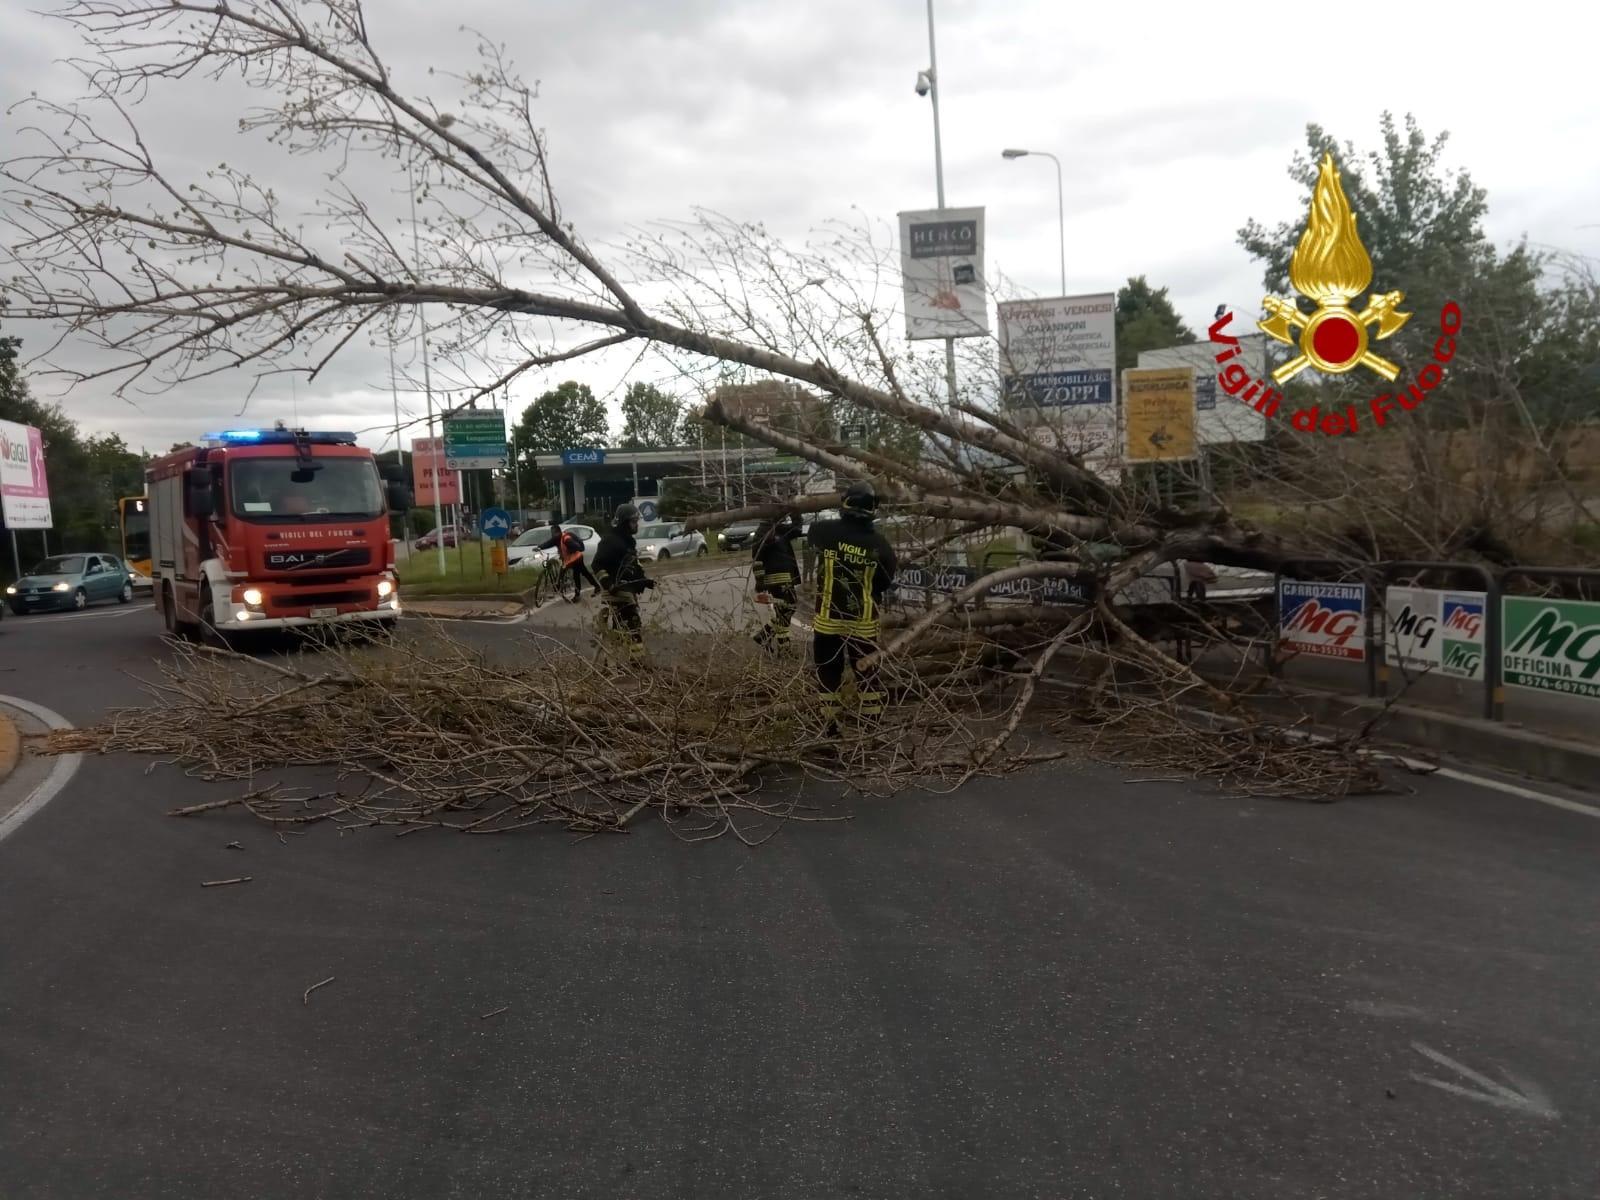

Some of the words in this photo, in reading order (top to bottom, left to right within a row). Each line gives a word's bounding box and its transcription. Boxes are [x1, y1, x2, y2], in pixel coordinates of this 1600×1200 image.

[1064, 304, 1112, 315] VENDESI
[1033, 374, 1110, 386] IMMOBILIARE
[1043, 385, 1100, 402] ZOPPI
[280, 531, 306, 539] VIGILI
[309, 530, 323, 538] DEL
[838, 541, 867, 556] VIGILI
[271, 554, 305, 563] BAI
[824, 549, 840, 560] DEL
[844, 553, 878, 569] FUOCO
[1283, 585, 1362, 600] CARROZZERIA
[1287, 602, 1360, 645] MG
[1390, 606, 1437, 648] MG
[1446, 607, 1481, 639] MG
[1445, 646, 1481, 677] MG
[1503, 655, 1572, 677] OFFICINA
